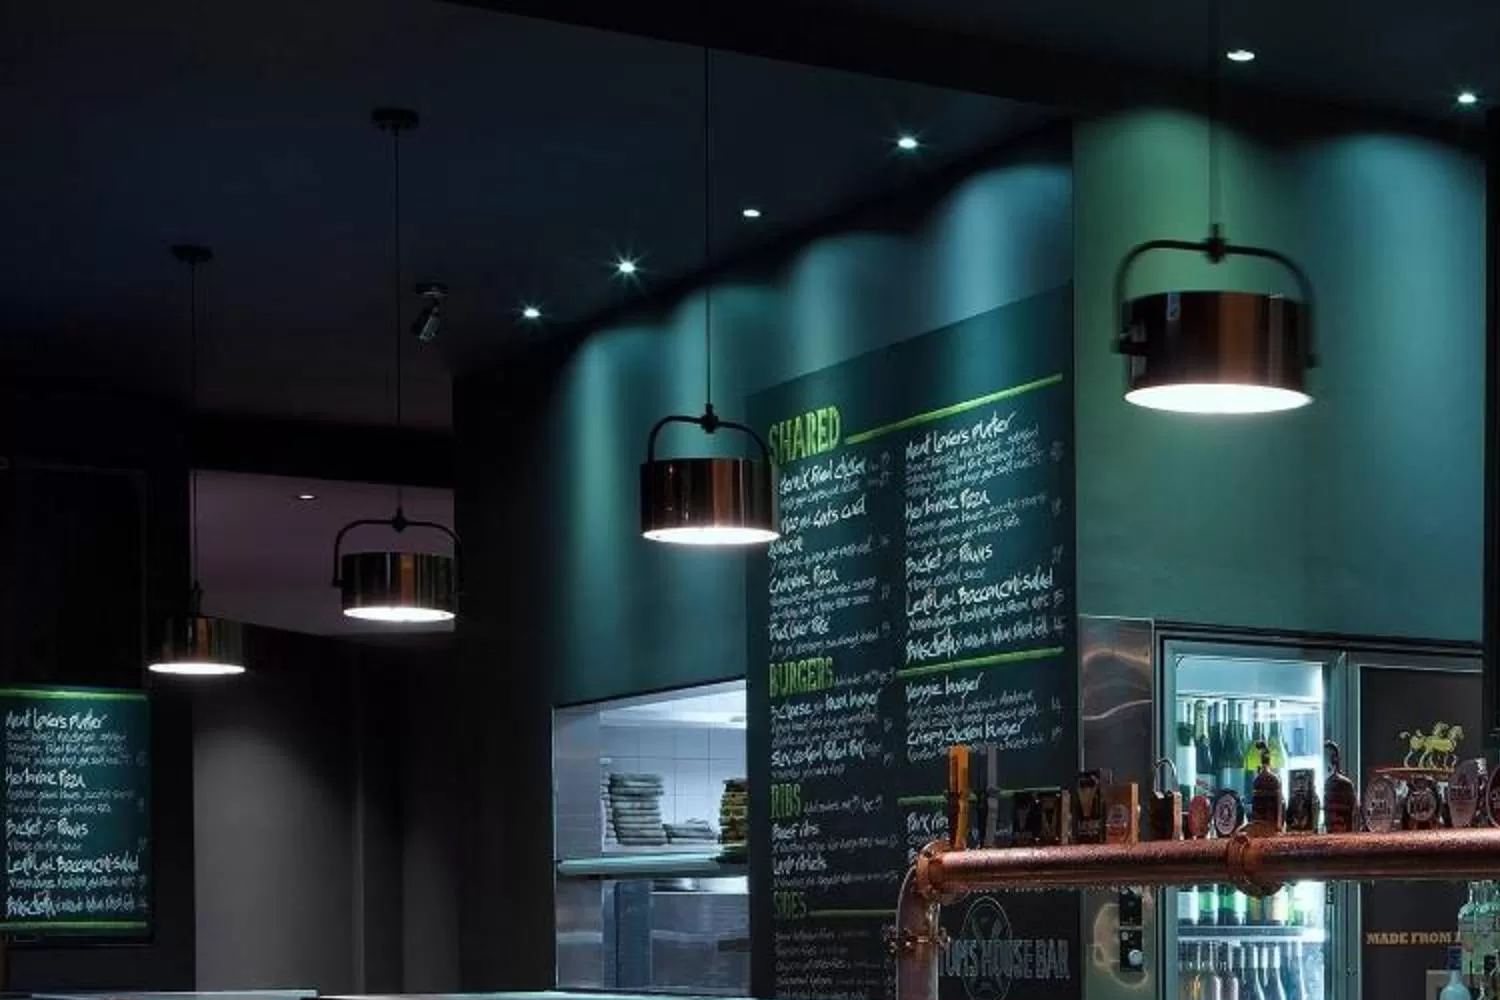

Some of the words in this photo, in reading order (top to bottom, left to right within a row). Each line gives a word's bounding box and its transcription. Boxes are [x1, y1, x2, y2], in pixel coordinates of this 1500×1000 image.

[768, 405, 842, 466] SHARED
[769, 656, 833, 698] BURGERS
[769, 783, 802, 819] RIBS
[1366, 931, 1408, 945] MADE
[1411, 929, 1450, 945] FROM
